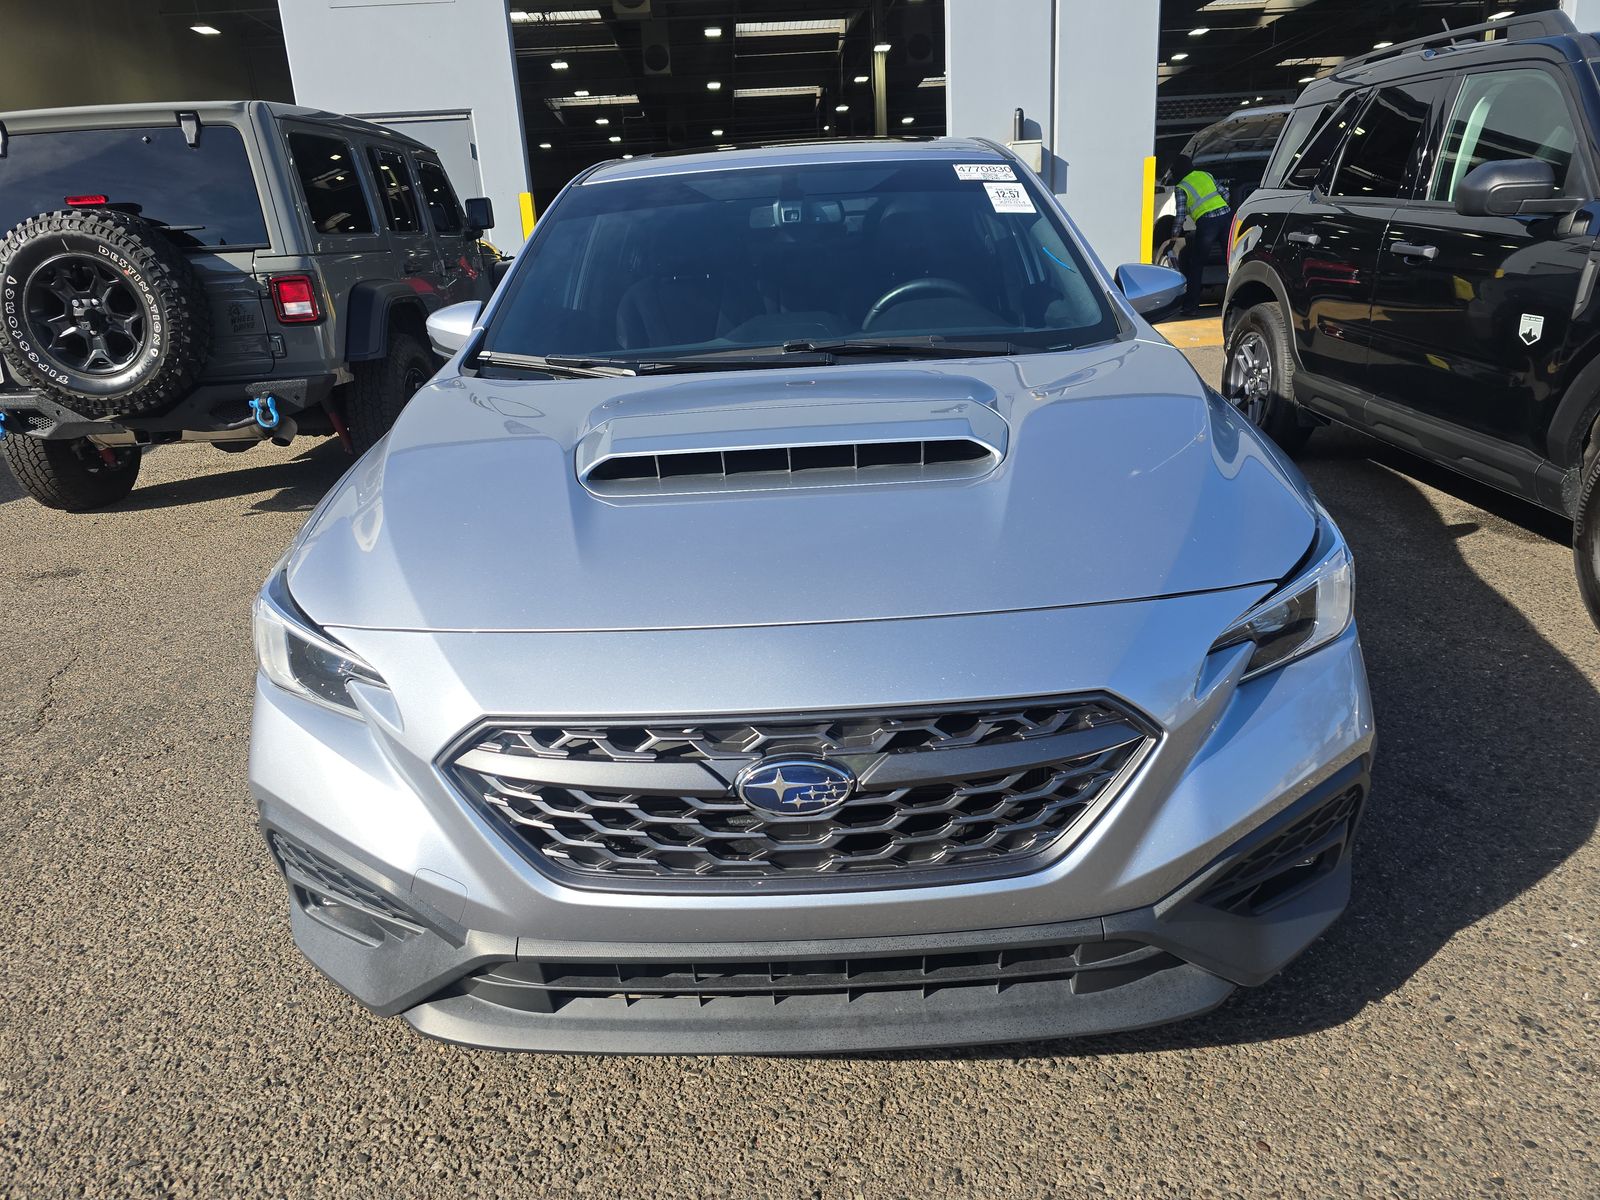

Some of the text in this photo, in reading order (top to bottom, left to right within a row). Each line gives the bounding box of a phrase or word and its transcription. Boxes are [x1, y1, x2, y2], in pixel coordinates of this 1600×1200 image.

[957, 165, 1012, 173] 4770830
[98, 245, 161, 346] DESTINATION
[1575, 458, 1600, 536] Continenta
